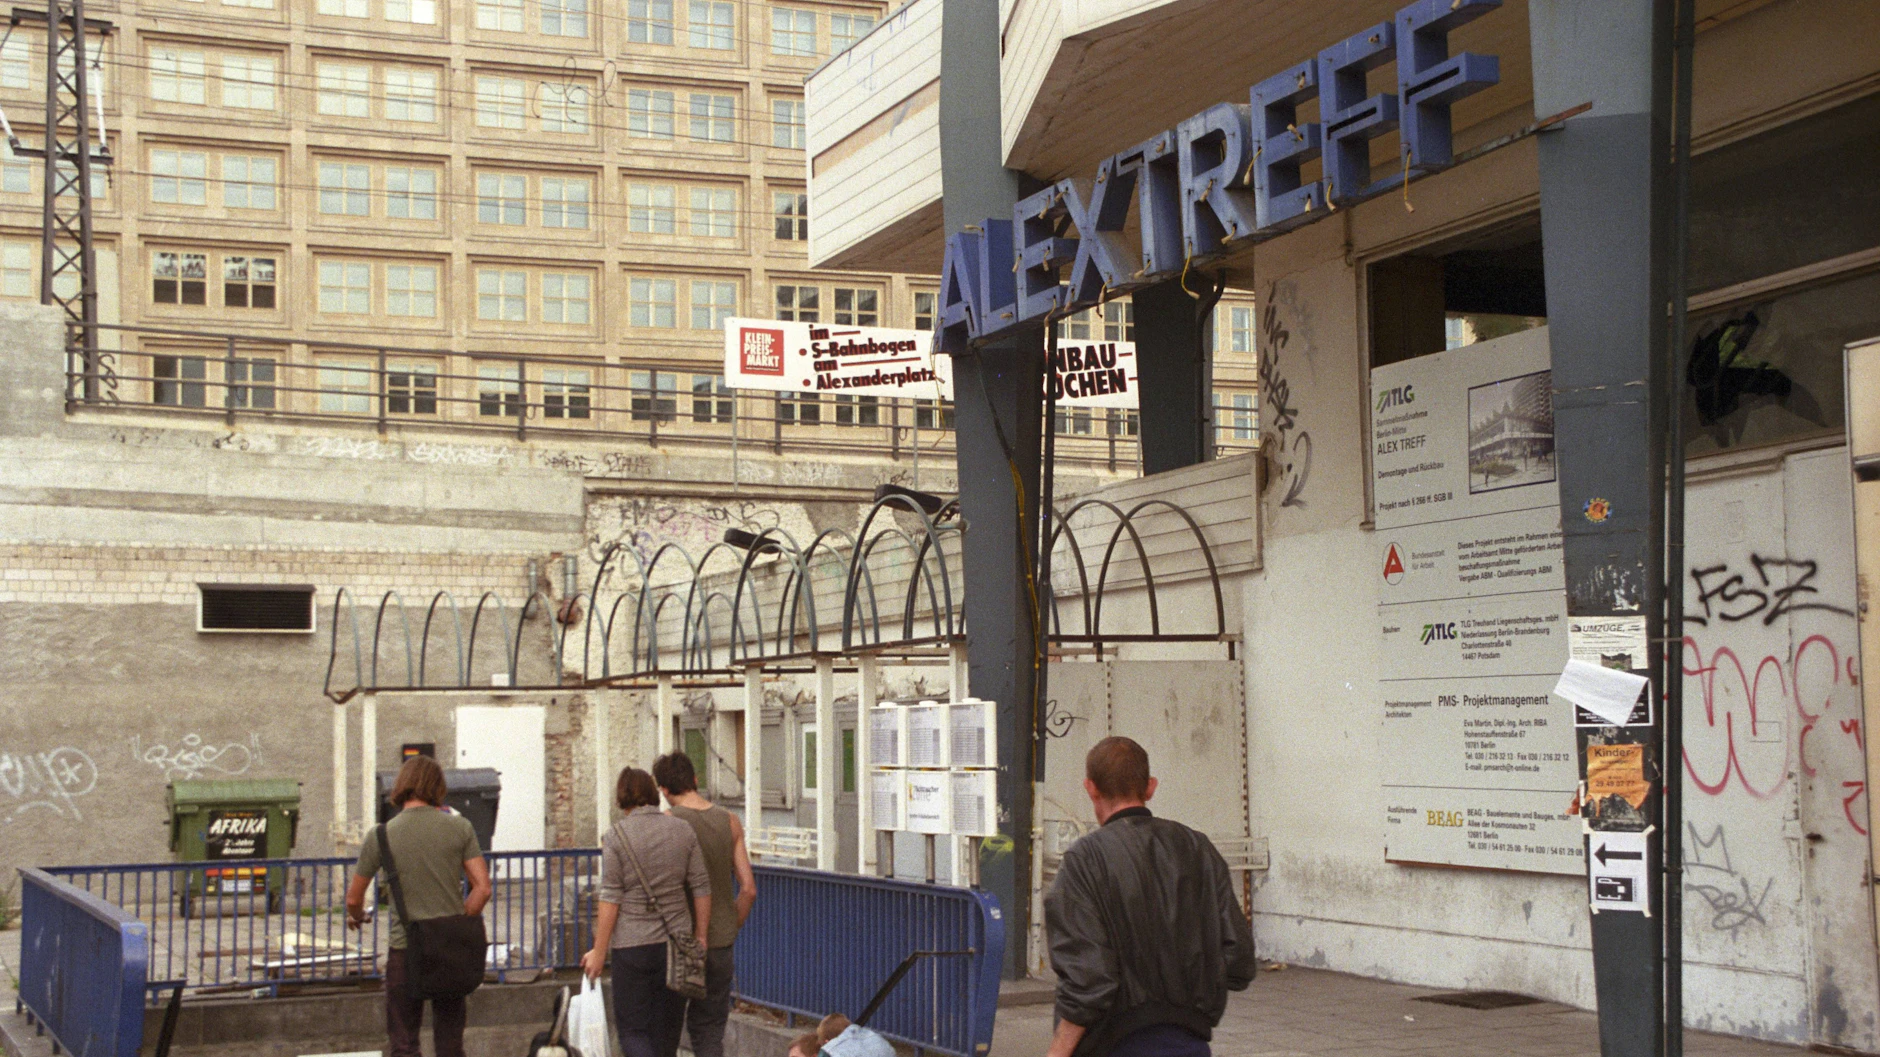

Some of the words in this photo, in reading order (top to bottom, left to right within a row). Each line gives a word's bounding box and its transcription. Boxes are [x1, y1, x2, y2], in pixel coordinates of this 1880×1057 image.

[745, 331, 775, 345] KLEIN-
[809, 324, 830, 341] im
[744, 342, 774, 356] PREIS-
[811, 337, 917, 359] S-Bahnbogen
[746, 354, 780, 367] MARKT
[813, 359, 838, 372] am
[816, 366, 936, 390] Alexanderplatz
[1377, 440, 1398, 455] ALEX
[1400, 434, 1426, 451] TREFF
[1378, 467, 1407, 479] Demontage
[1408, 463, 1419, 474] und
[1420, 461, 1444, 471] Rückbau
[1379, 501, 1397, 511] Projekt
[1398, 499, 1410, 508] nach
[1458, 541, 1474, 550] Dieses
[1475, 538, 1493, 548] Projekt
[1494, 536, 1516, 545] entsteht
[1525, 533, 1548, 541] Rahmen
[1471, 550, 1498, 559] Arbeitsamt
[1499, 547, 1513, 555] Mitte
[1514, 545, 1545, 555] geförderten
[1458, 573, 1479, 583] Vergabe
[1481, 571, 1493, 579] ABM
[1538, 565, 1552, 574] ABM
[1461, 620, 1471, 628] TLG
[1473, 619, 1496, 627] Treuhand
[1545, 614, 1559, 622] mbH
[1461, 630, 1497, 639] Niederlassung
[1498, 627, 1550, 636] Berlin-Brandenburg
[1461, 640, 1504, 649] Charlottenstraße
[1478, 651, 1500, 659] Potsdam
[1385, 700, 1432, 709] Projektmanagement
[1438, 695, 1460, 707] PMS-
[1463, 694, 1549, 708] Projektmanagement
[1385, 710, 1412, 718] Architekten
[1464, 719, 1473, 727] Eva
[1534, 718, 1547, 726] RIBA
[1481, 741, 1496, 749] Berlin
[1517, 752, 1527, 760] Fax
[1427, 809, 1464, 828] BEAG
[1467, 808, 1482, 817] BEAG
[1486, 809, 1520, 818] Bauelemente
[1522, 810, 1532, 819] und
[209, 817, 267, 835] AFRIKA
[1467, 819, 1480, 827] Allee
[1491, 820, 1528, 830] Kosmonauten
[1483, 831, 1498, 839] Berlin
[1524, 844, 1534, 853] Fax
